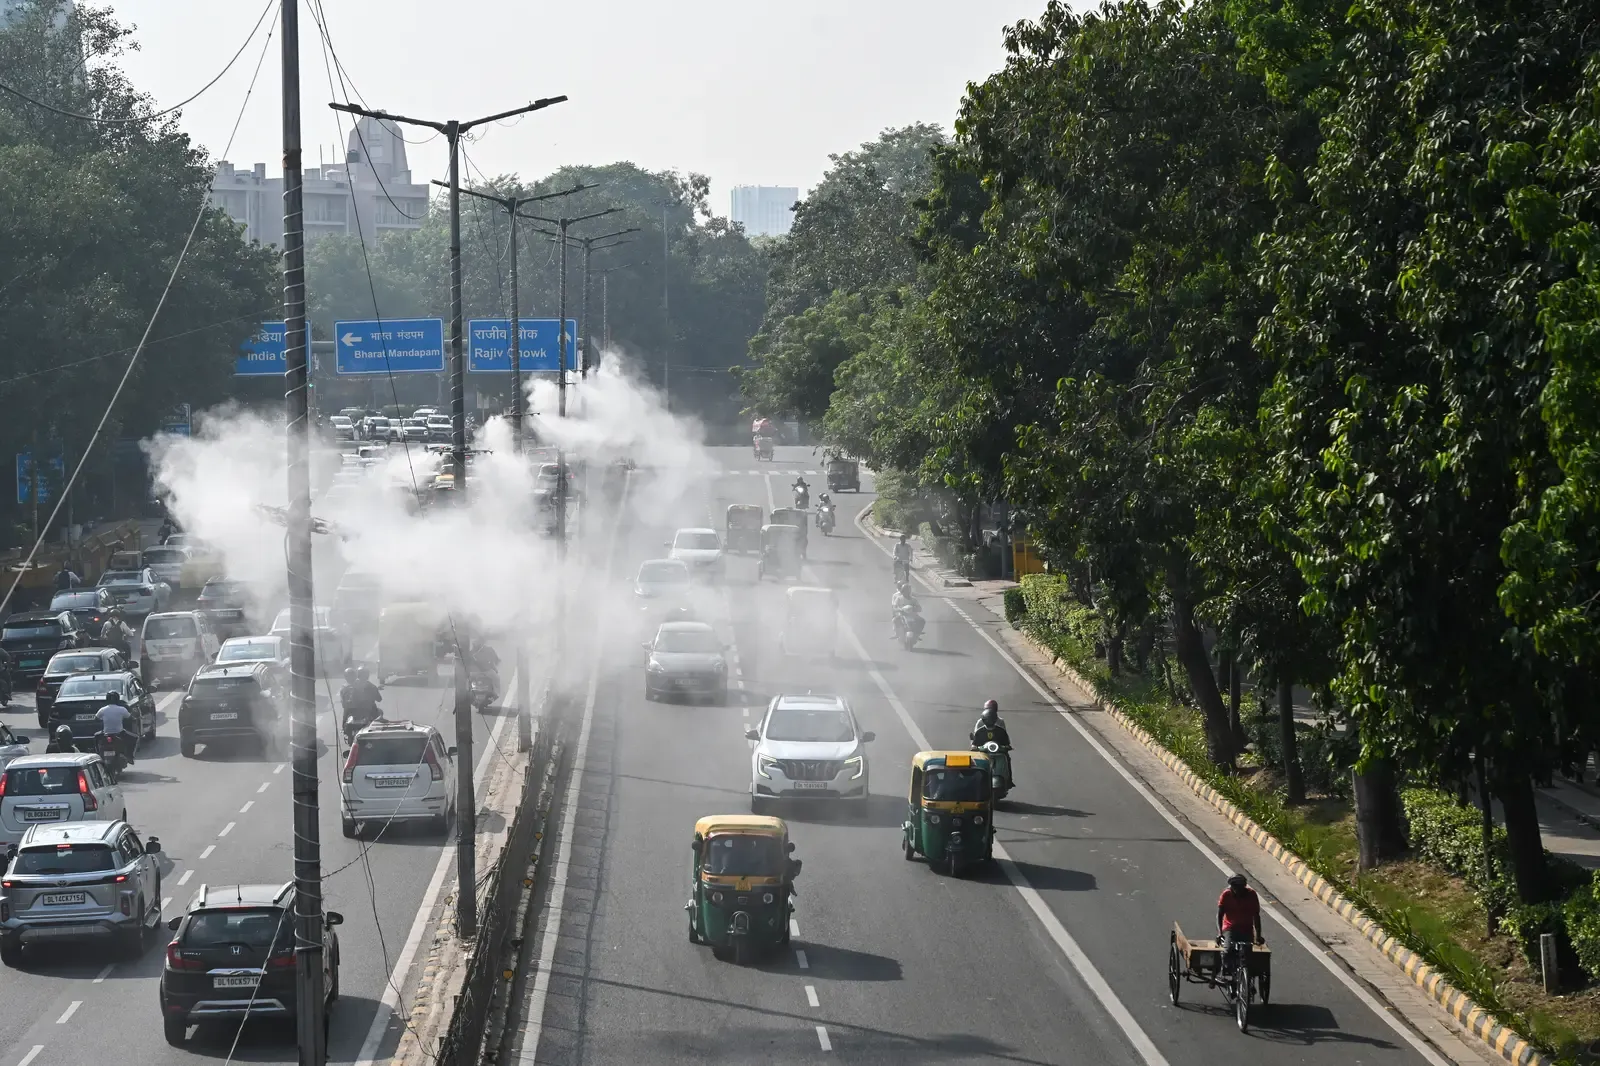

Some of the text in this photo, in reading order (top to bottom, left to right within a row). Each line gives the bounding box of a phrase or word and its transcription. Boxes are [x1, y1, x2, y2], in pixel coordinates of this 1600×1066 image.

[370, 330, 424, 341] भारत मंडपम
[474, 326, 507, 340] राजीव
[247, 351, 276, 361] India
[354, 348, 440, 359] Bharat Mandapam
[474, 348, 503, 360] Rajiv
